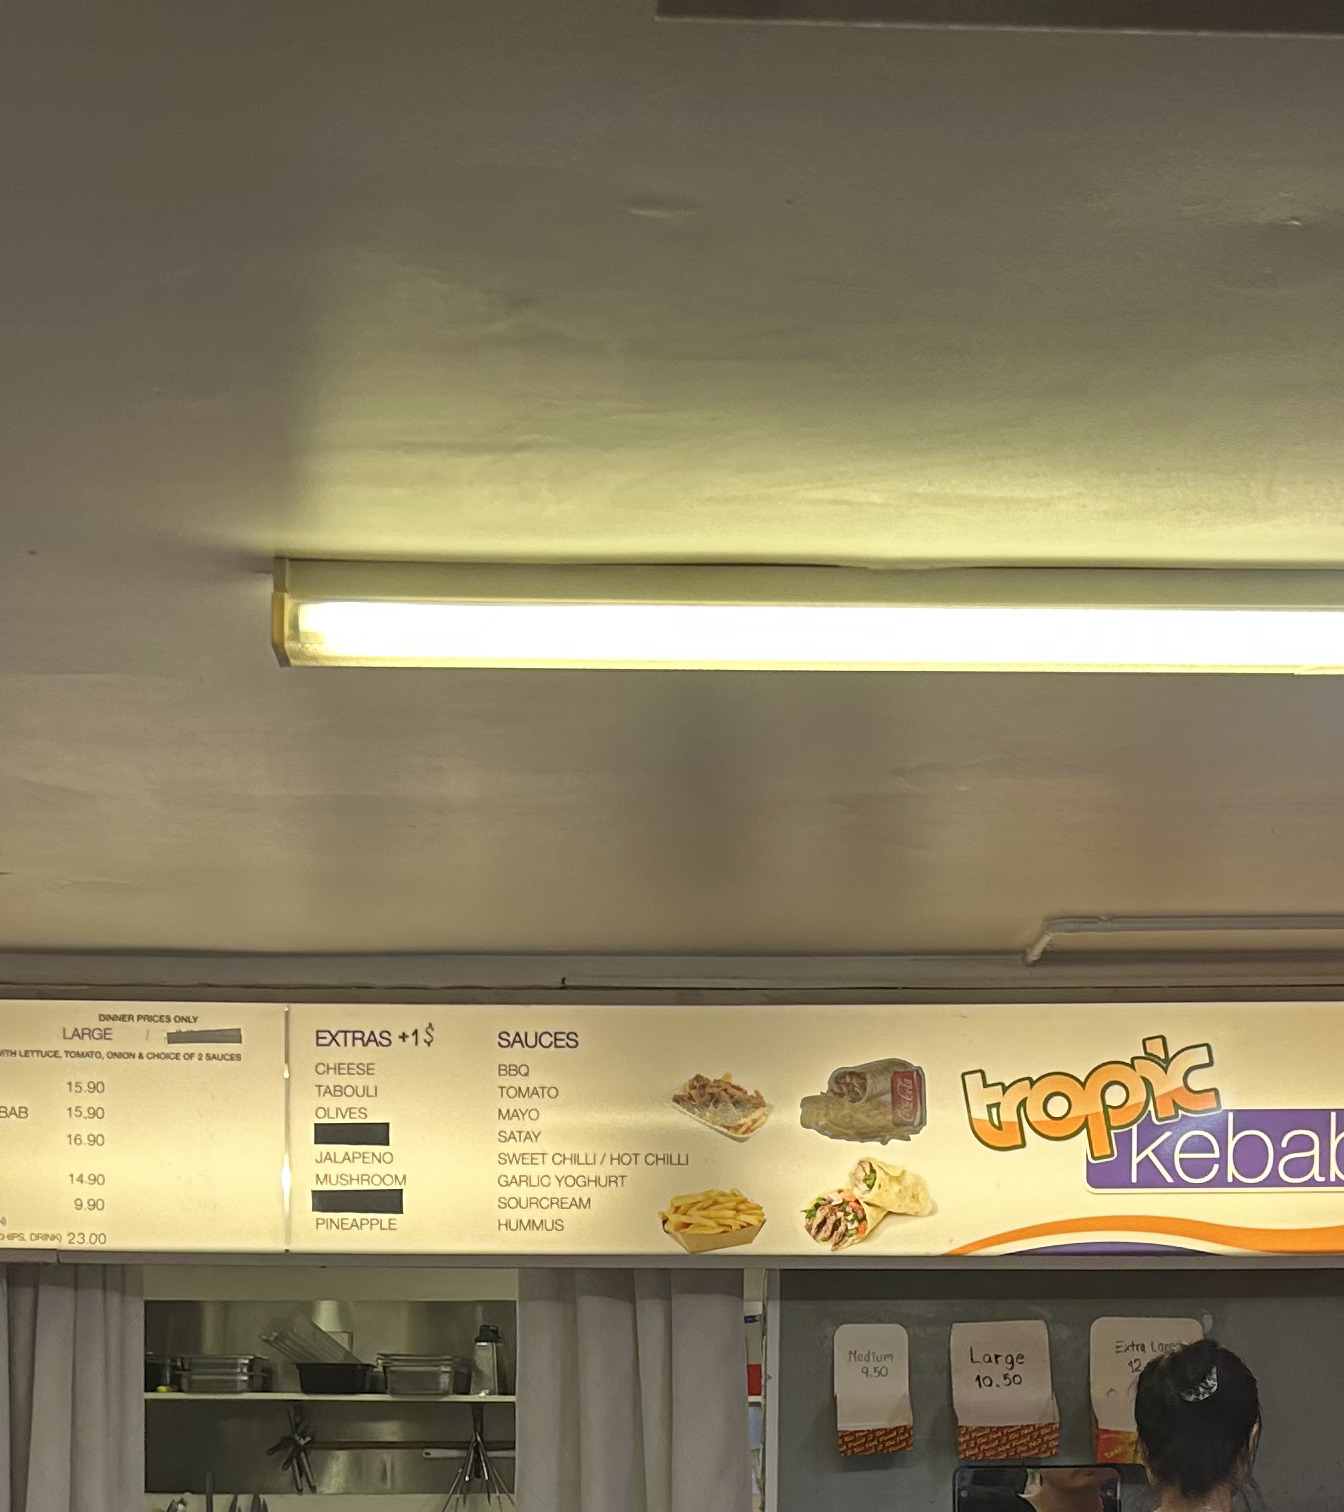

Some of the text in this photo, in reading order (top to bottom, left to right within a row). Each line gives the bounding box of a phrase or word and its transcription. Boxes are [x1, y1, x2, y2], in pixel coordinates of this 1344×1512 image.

[98, 1014, 199, 1024] DINNER PRICES ONLY
[62, 1027, 113, 1041] LARGE
[315, 1030, 392, 1048] EXTRAS
[497, 1031, 580, 1049] SAUCES
[19, 1050, 62, 1059] LETTUCE,
[64, 1050, 105, 1060] TOMATO,
[107, 1051, 136, 1060] ONION
[138, 1052, 144, 1060] &
[146, 1052, 181, 1060] CHOICE
[183, 1053, 196, 1061] OF
[197, 1053, 203, 1061] 2
[205, 1053, 242, 1061] SAUCES
[315, 1062, 376, 1076] CHEESE
[497, 1063, 530, 1077] BBQ
[67, 1081, 105, 1093] 15.90
[315, 1085, 378, 1098] TABOULI
[498, 1086, 559, 1099] TOMATO
[961, 1034, 1220, 1161] tropic
[67, 1106, 105, 1119] 15.90
[315, 1107, 369, 1120] OLIVES
[498, 1108, 540, 1121] MAYO
[67, 1133, 105, 1146] 16.90
[497, 1130, 542, 1144] SATAY
[314, 1151, 394, 1164] JALAPENO
[497, 1152, 548, 1166] SWEET
[552, 1152, 597, 1166] CHILLI
[609, 1152, 641, 1166] HOT
[644, 1152, 689, 1167] CHILLI
[68, 1173, 106, 1185] 14.90
[315, 1173, 407, 1187] MUSHROOM
[497, 1174, 628, 1188] GARLIC YOGHURT
[73, 1198, 105, 1211] 9.90
[497, 1197, 592, 1210] SOURCREAM
[315, 1218, 398, 1231] PINEAPPLE
[497, 1218, 564, 1232] HUMMUS
[67, 1232, 107, 1245] 23.00
[1114, 1340, 1146, 1354] Extra
[969, 1346, 1025, 1370] Large
[861, 1365, 889, 1378] 9.50
[974, 1373, 1023, 1389] 10.50
